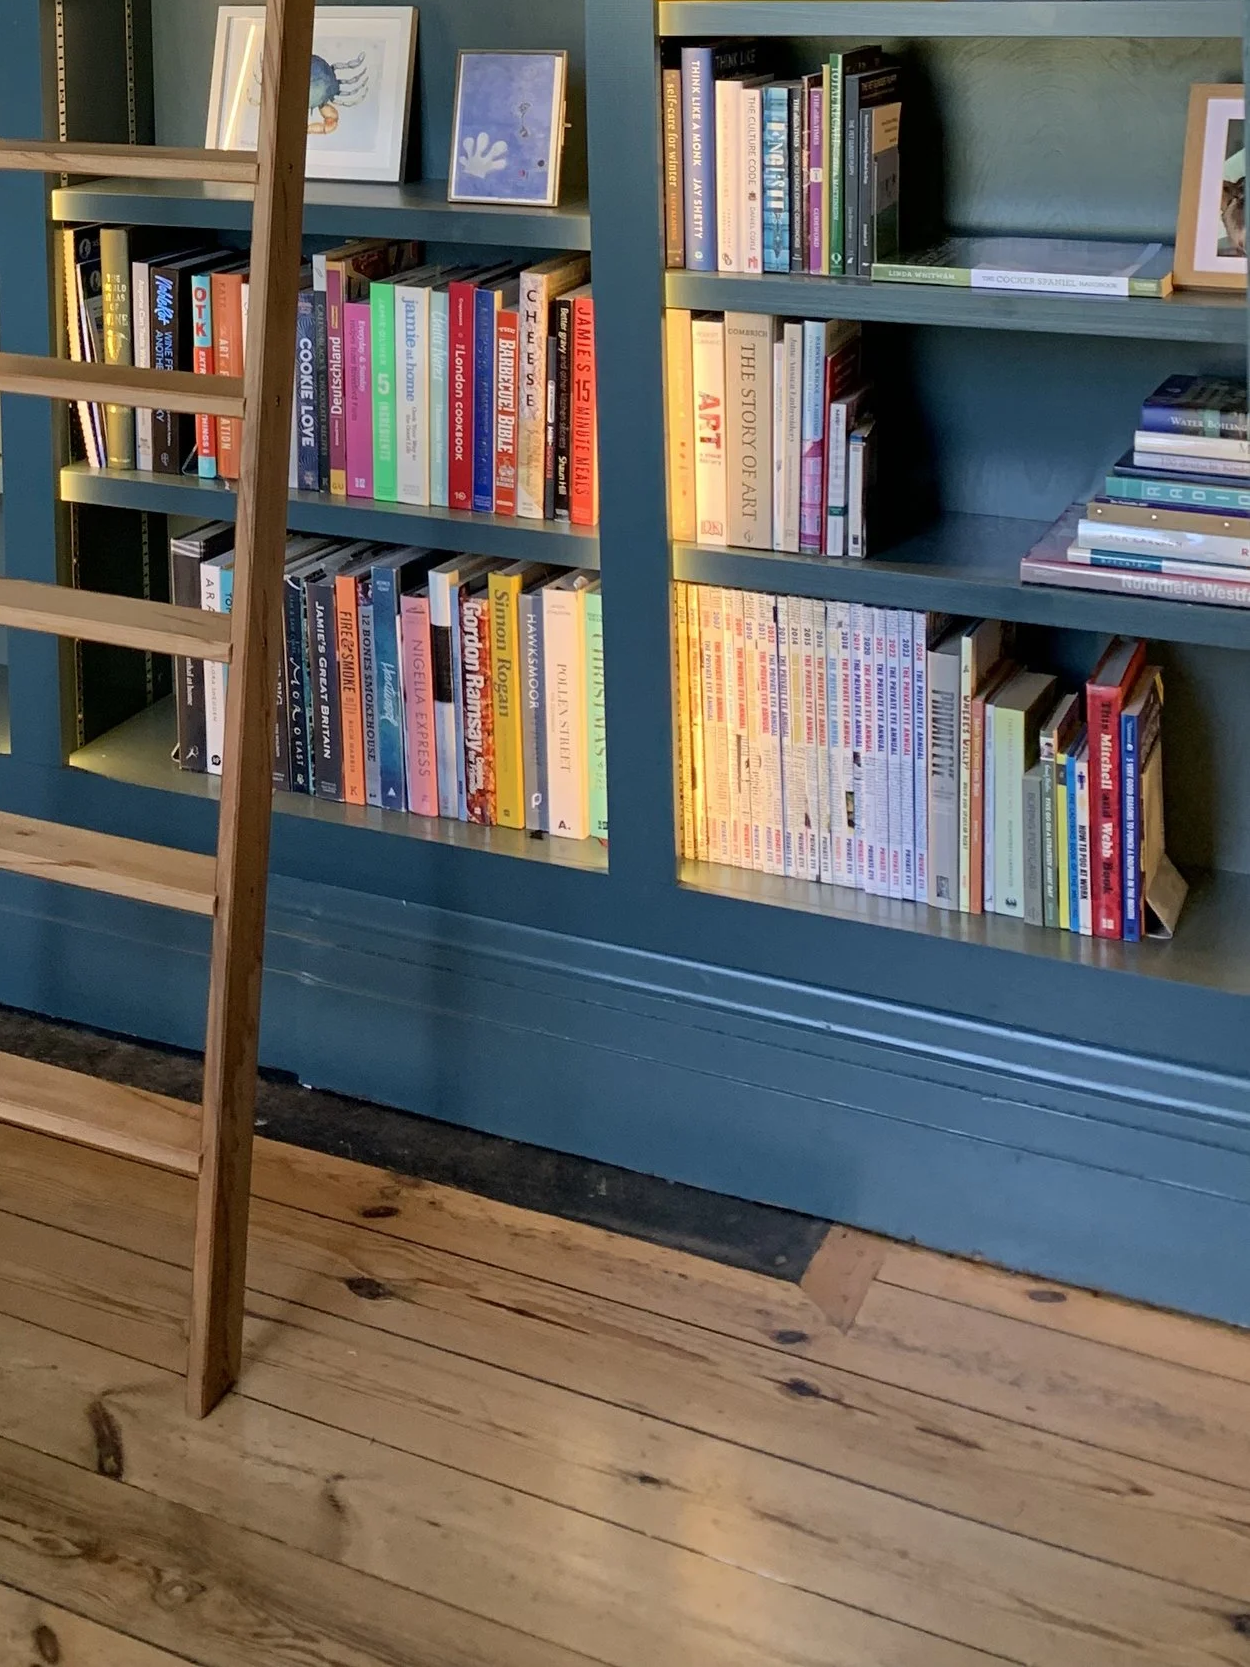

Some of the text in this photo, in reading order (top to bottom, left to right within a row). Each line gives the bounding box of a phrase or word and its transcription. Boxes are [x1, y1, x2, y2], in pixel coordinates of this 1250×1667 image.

[666, 83, 679, 187] self-care for winter
[691, 60, 703, 239] THINK LIKE A MONK JAY SHETTY
[748, 96, 756, 185] THE CULTURE CODE
[559, 307, 569, 331] Better
[996, 275, 1036, 286] COCKER
[164, 330, 173, 356] WINE
[219, 338, 230, 359] ART
[299, 337, 314, 447] COOKIE LOVE
[329, 337, 342, 415] Deutschland
[401, 297, 420, 402] jamie at home
[455, 350, 466, 399] London
[526, 289, 537, 407] CHEESE
[498, 338, 516, 454] BARBECUE! BIBLE
[575, 306, 591, 496] JAMIE'S 15 MINUTE MEALS
[698, 391, 721, 450] ART
[740, 343, 758, 522] THE STORY OF ART
[1170, 416, 1204, 428] WATER
[315, 601, 331, 759] JAMIE'S GREAT BRITAIN
[461, 601, 485, 752] Gordon Ramsay
[494, 589, 512, 718] Simon Rogan
[526, 613, 539, 709] HAWKSMOOR
[803, 627, 812, 647] 2015
[902, 638, 910, 658] 2023
[361, 613, 376, 762] 12 BONES SMOKEHOUSE
[411, 638, 431, 778] NIGELLA EXPRESS
[295, 740, 304, 766] EAST
[1079, 825, 1088, 900] HOW TO POO AT WORK
[1101, 733, 1114, 895] Mitchell and Webb Book
